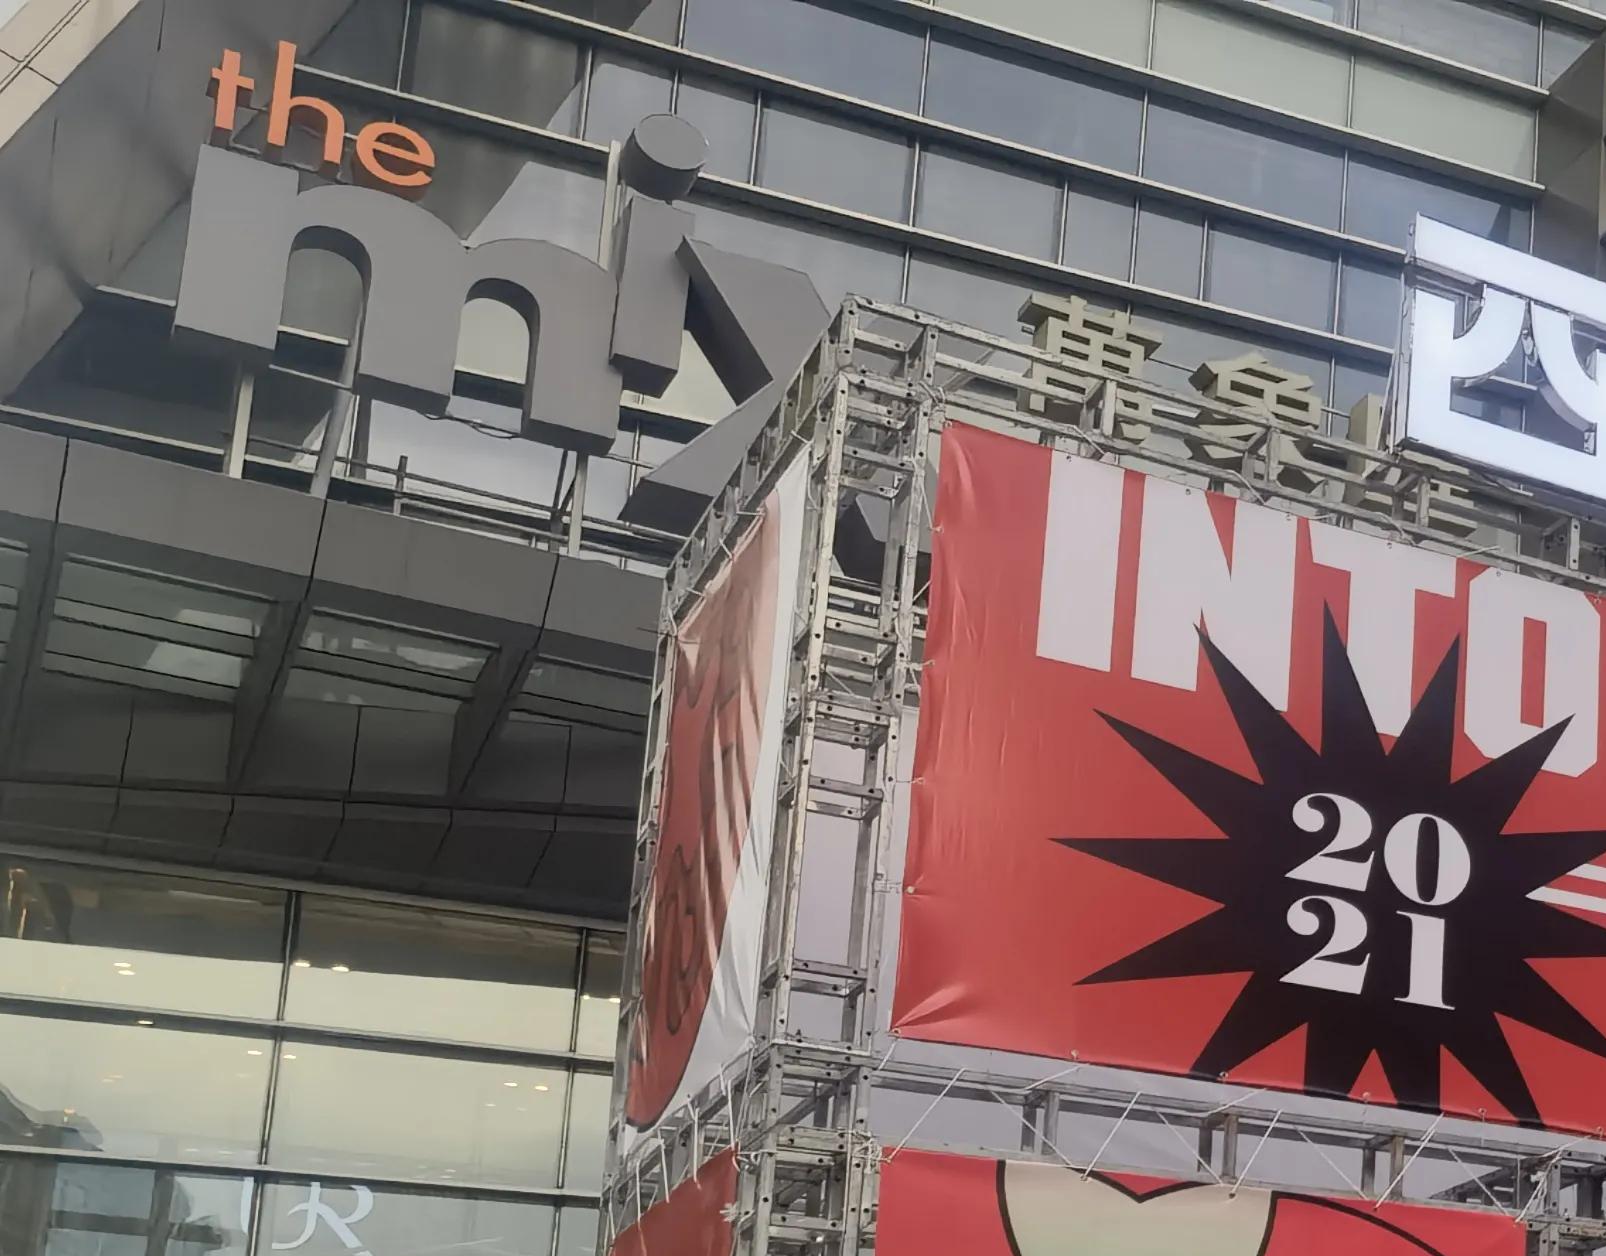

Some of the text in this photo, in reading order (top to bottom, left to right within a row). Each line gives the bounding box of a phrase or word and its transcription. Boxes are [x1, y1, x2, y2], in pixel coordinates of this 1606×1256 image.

[212, 41, 436, 187] the
[1036, 450, 1600, 777] INTO
[1286, 793, 1471, 906] 20
[1279, 897, 1451, 1010] 21
